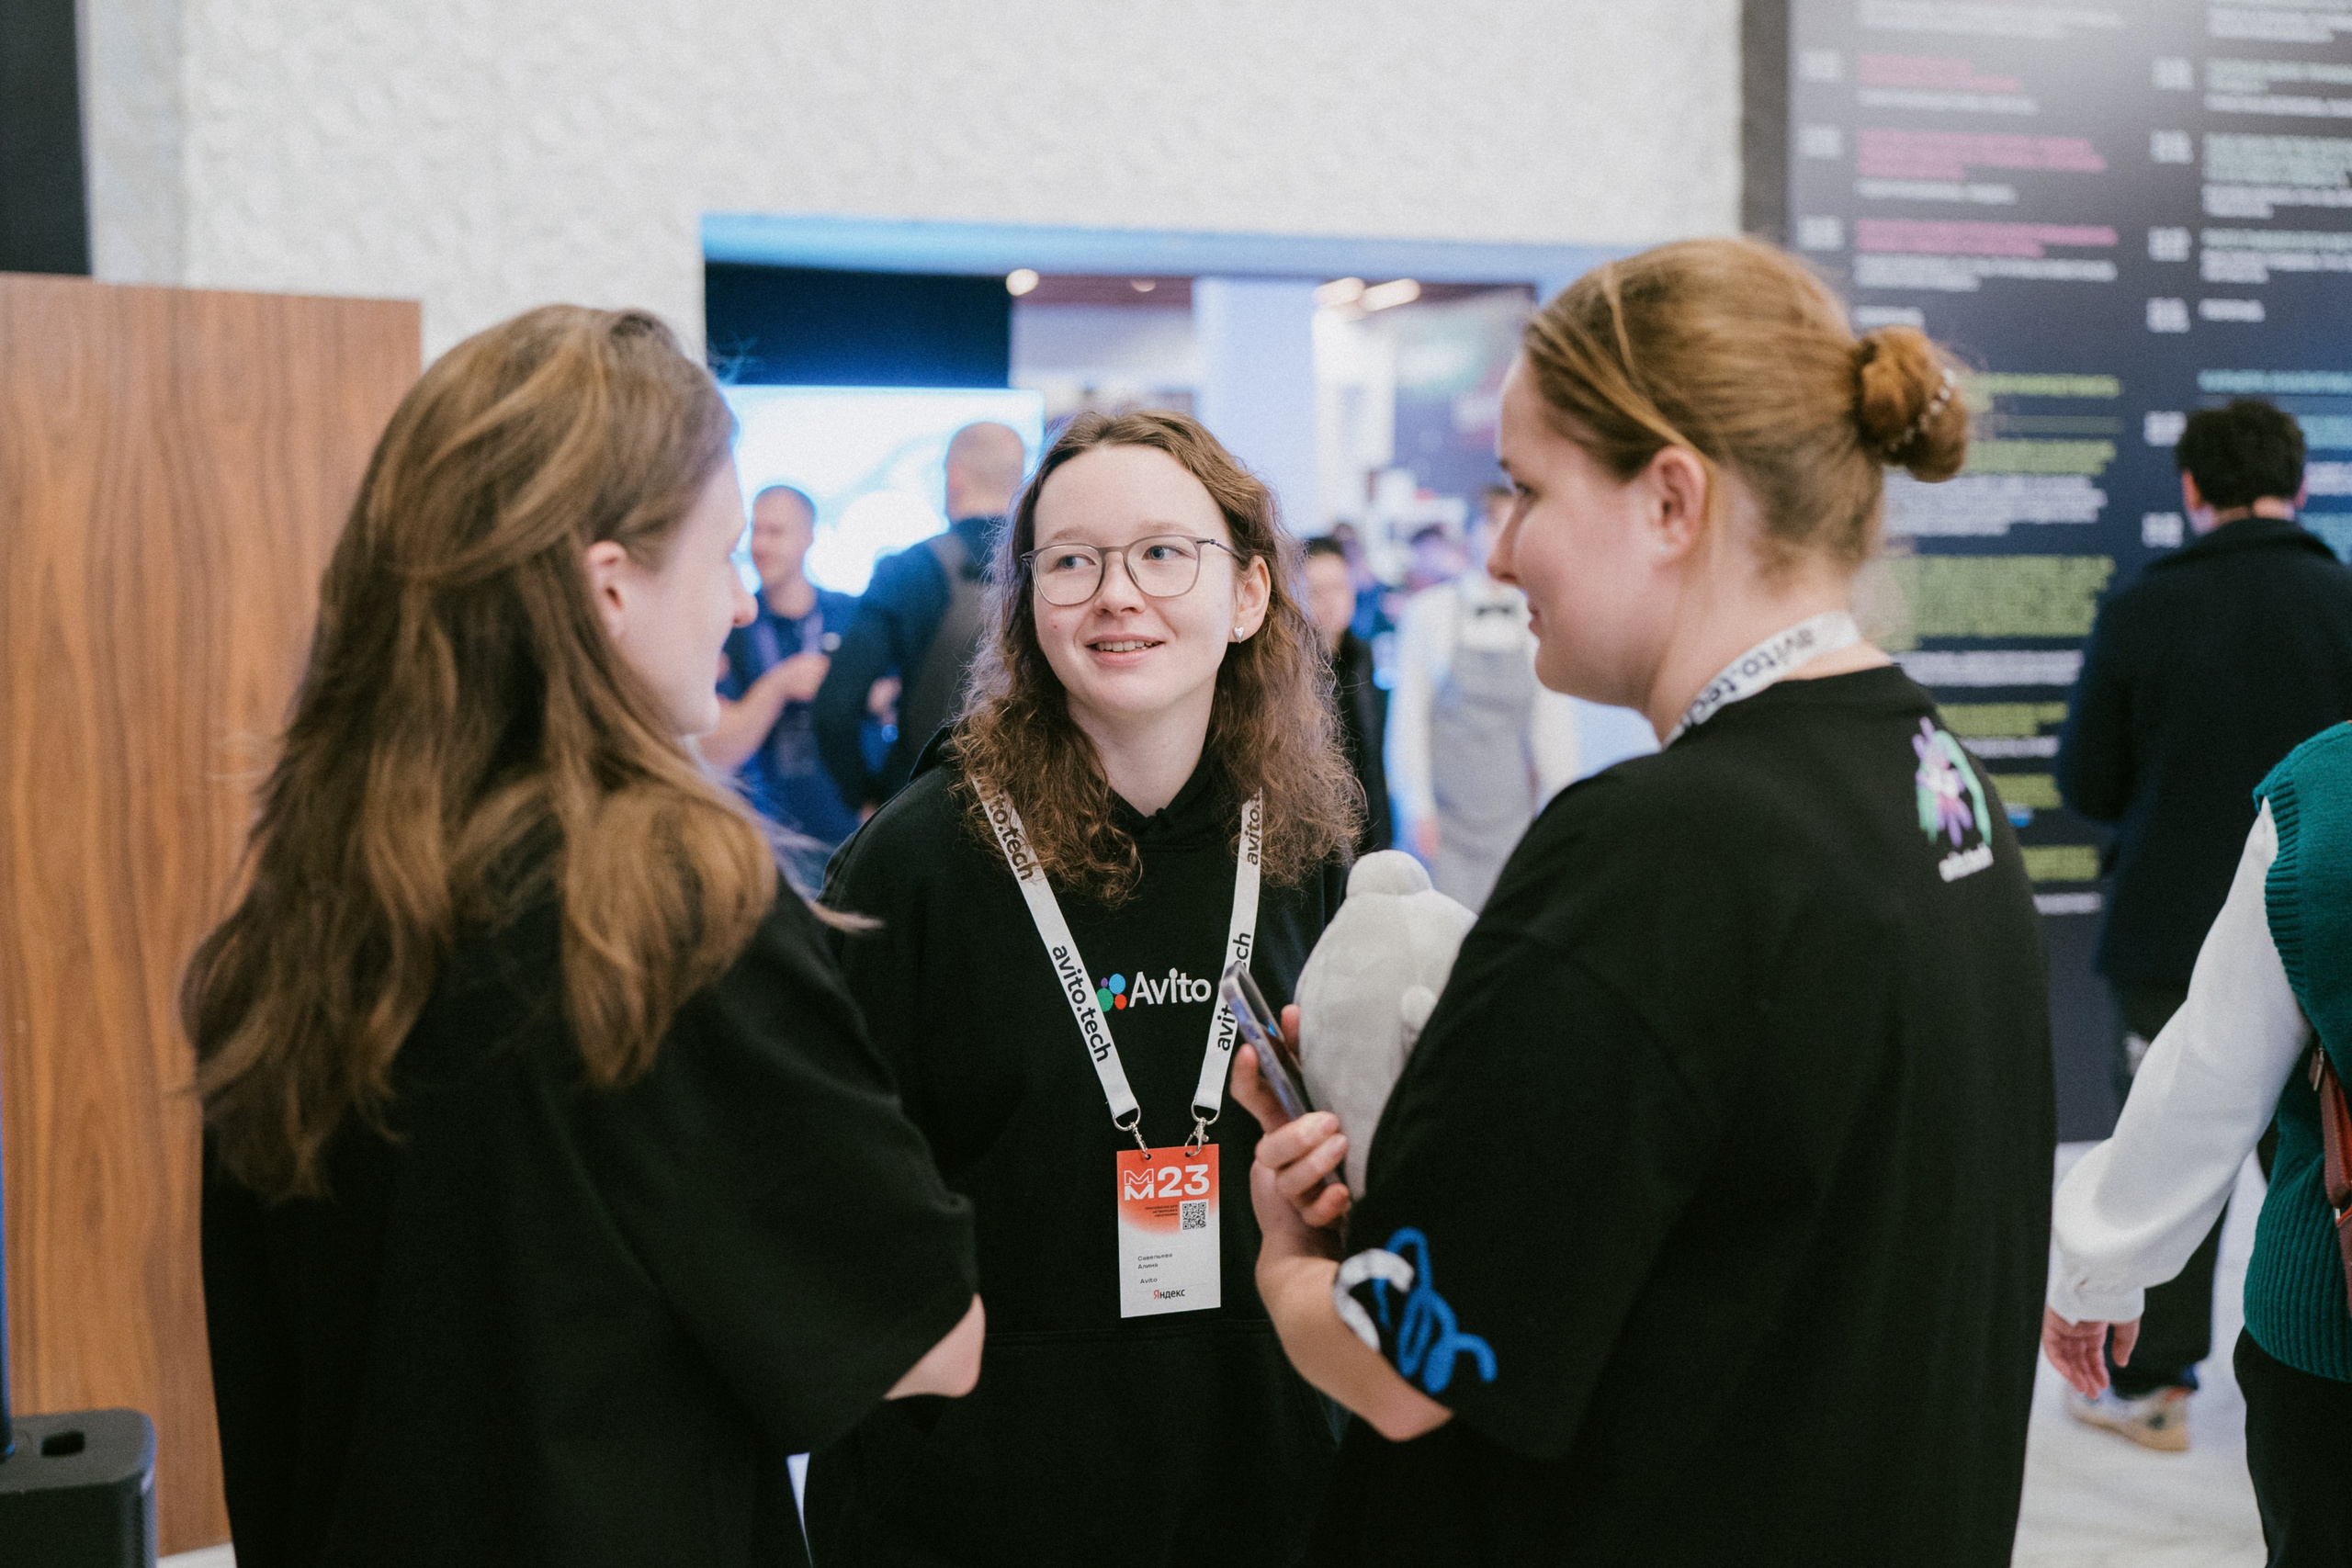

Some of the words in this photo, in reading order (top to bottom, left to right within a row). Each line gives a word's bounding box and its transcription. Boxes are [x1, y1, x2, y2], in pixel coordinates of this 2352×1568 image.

[1128, 967, 1212, 1008] Avito
[1052, 945, 1112, 1063] avito.tech
[1137, 1253, 1173, 1261] Савельева
[1153, 1289, 1186, 1300] Яндекс
